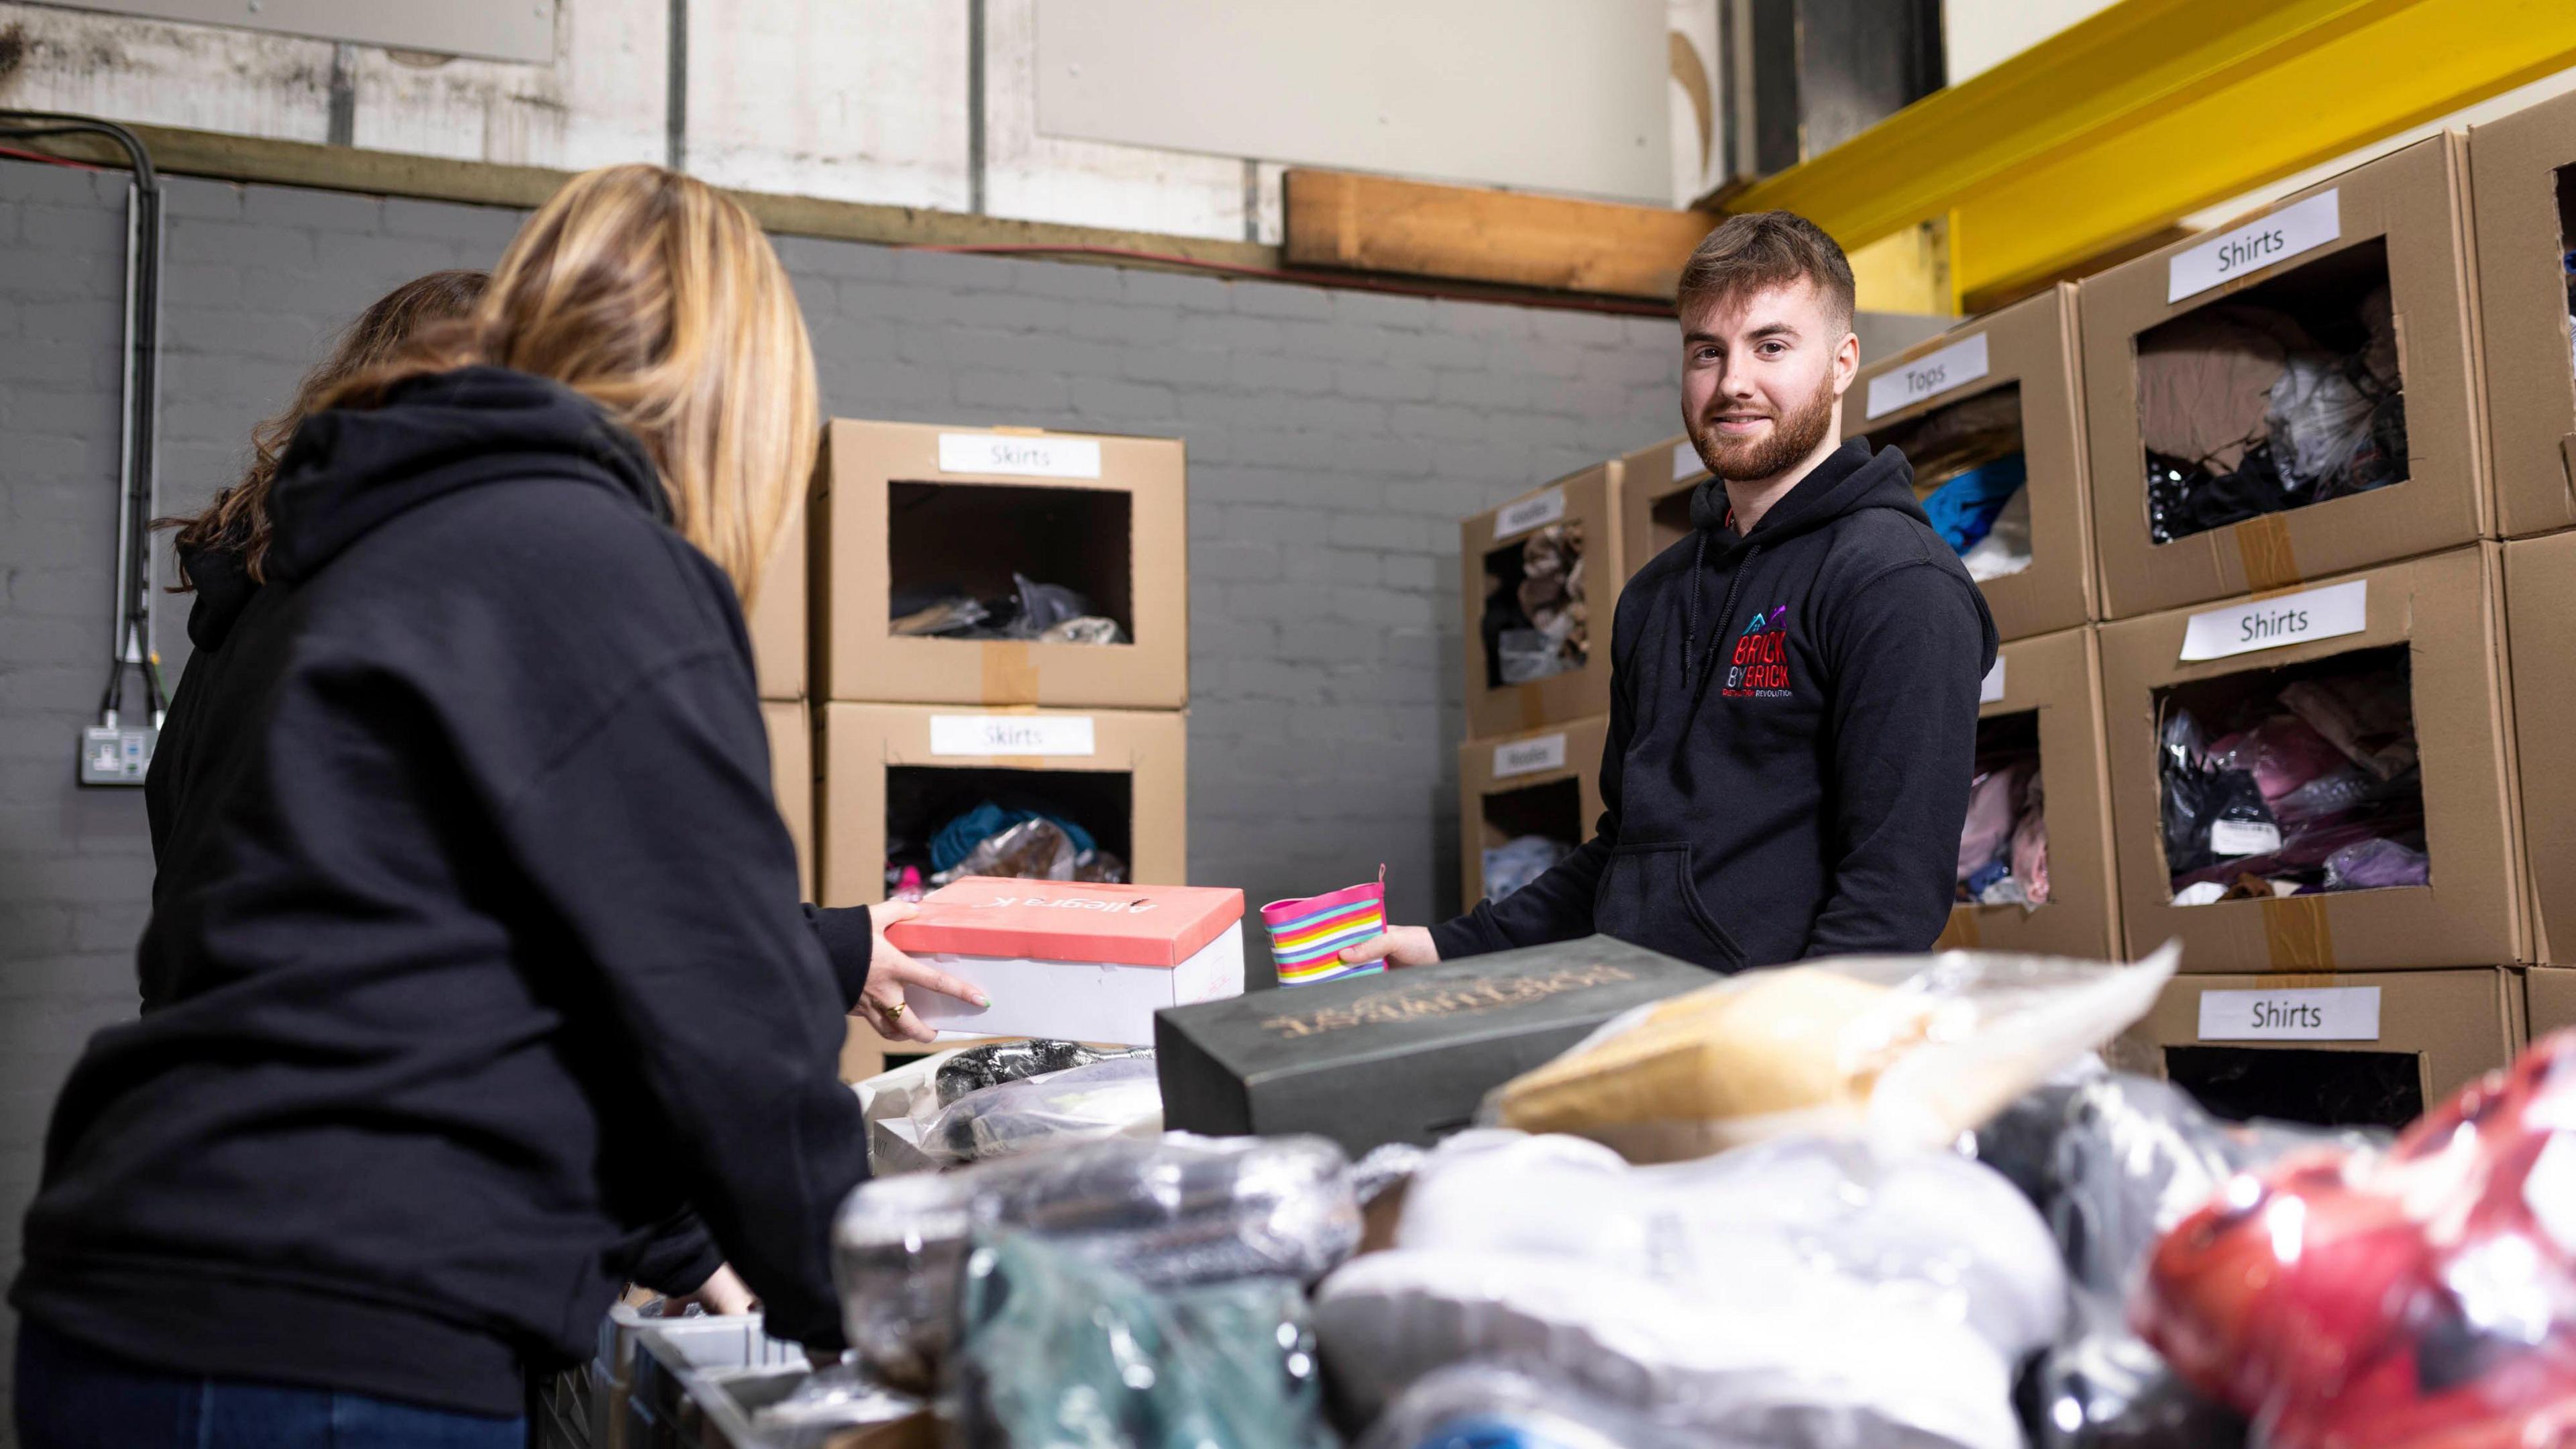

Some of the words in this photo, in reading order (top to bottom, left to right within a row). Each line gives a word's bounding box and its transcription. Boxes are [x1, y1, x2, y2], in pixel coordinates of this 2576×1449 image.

[2218, 229, 2284, 272] Shirts
[1906, 364, 1947, 394] Tops
[991, 445, 1051, 467] Skirts
[2241, 608, 2308, 641] Shirts
[1732, 632, 1788, 665] BRICK
[1727, 666, 1746, 687] BY
[1744, 665, 1790, 688] BRICK
[1756, 689, 1793, 698] REVOLUTION
[986, 724, 1042, 746] Skirts
[1024, 896, 1159, 914] Allegra
[2251, 1000, 2321, 1028] Shirts
